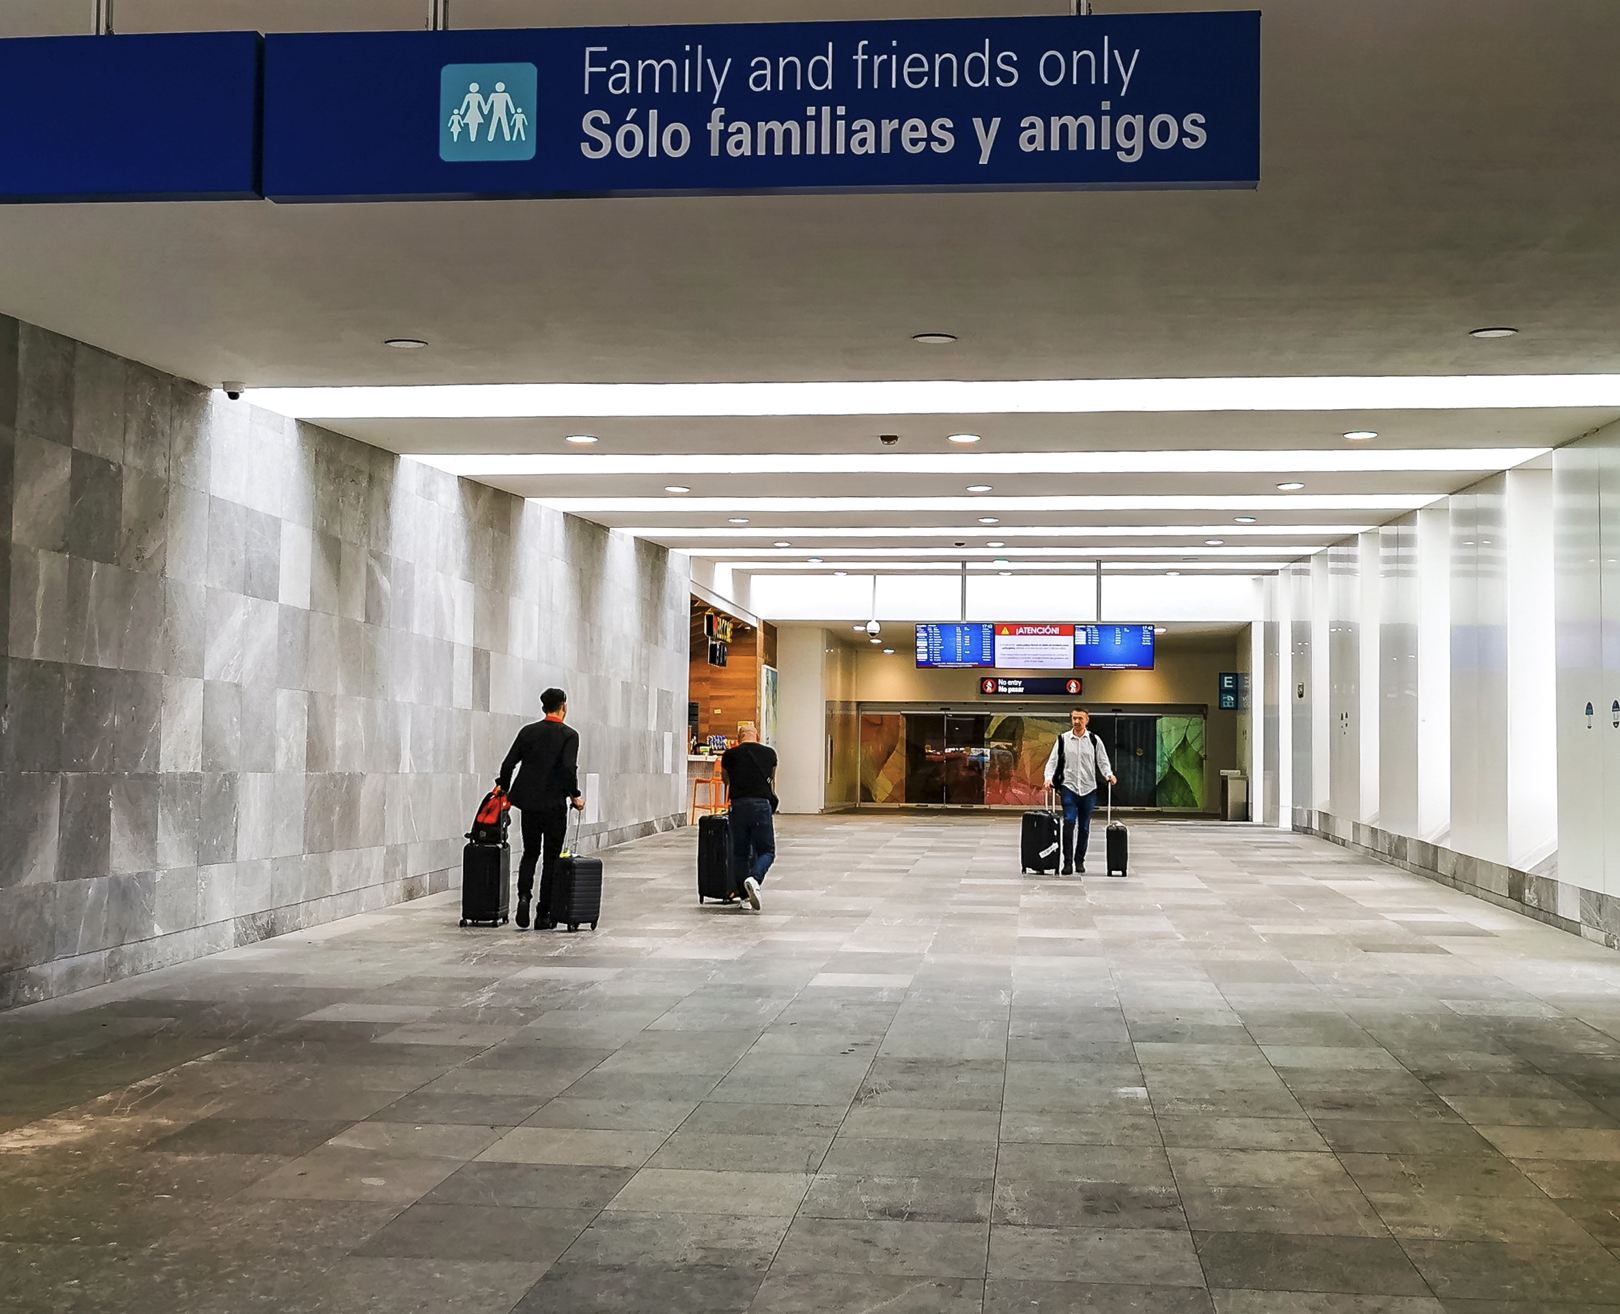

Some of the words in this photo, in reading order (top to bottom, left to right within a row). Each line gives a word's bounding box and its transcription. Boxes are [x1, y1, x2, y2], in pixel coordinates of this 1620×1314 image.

[585, 43, 731, 105] Family
[749, 41, 833, 92] and
[853, 38, 1018, 90] friends
[1039, 35, 1140, 97] only
[580, 106, 690, 159] Sólo
[706, 105, 954, 157] familiares
[973, 117, 1002, 165] y
[1019, 101, 1207, 164] amigos
[1015, 625, 1060, 635] ¡ATENCIÓN!
[1008, 679, 1022, 687] entry
[1224, 676, 1233, 688] E
